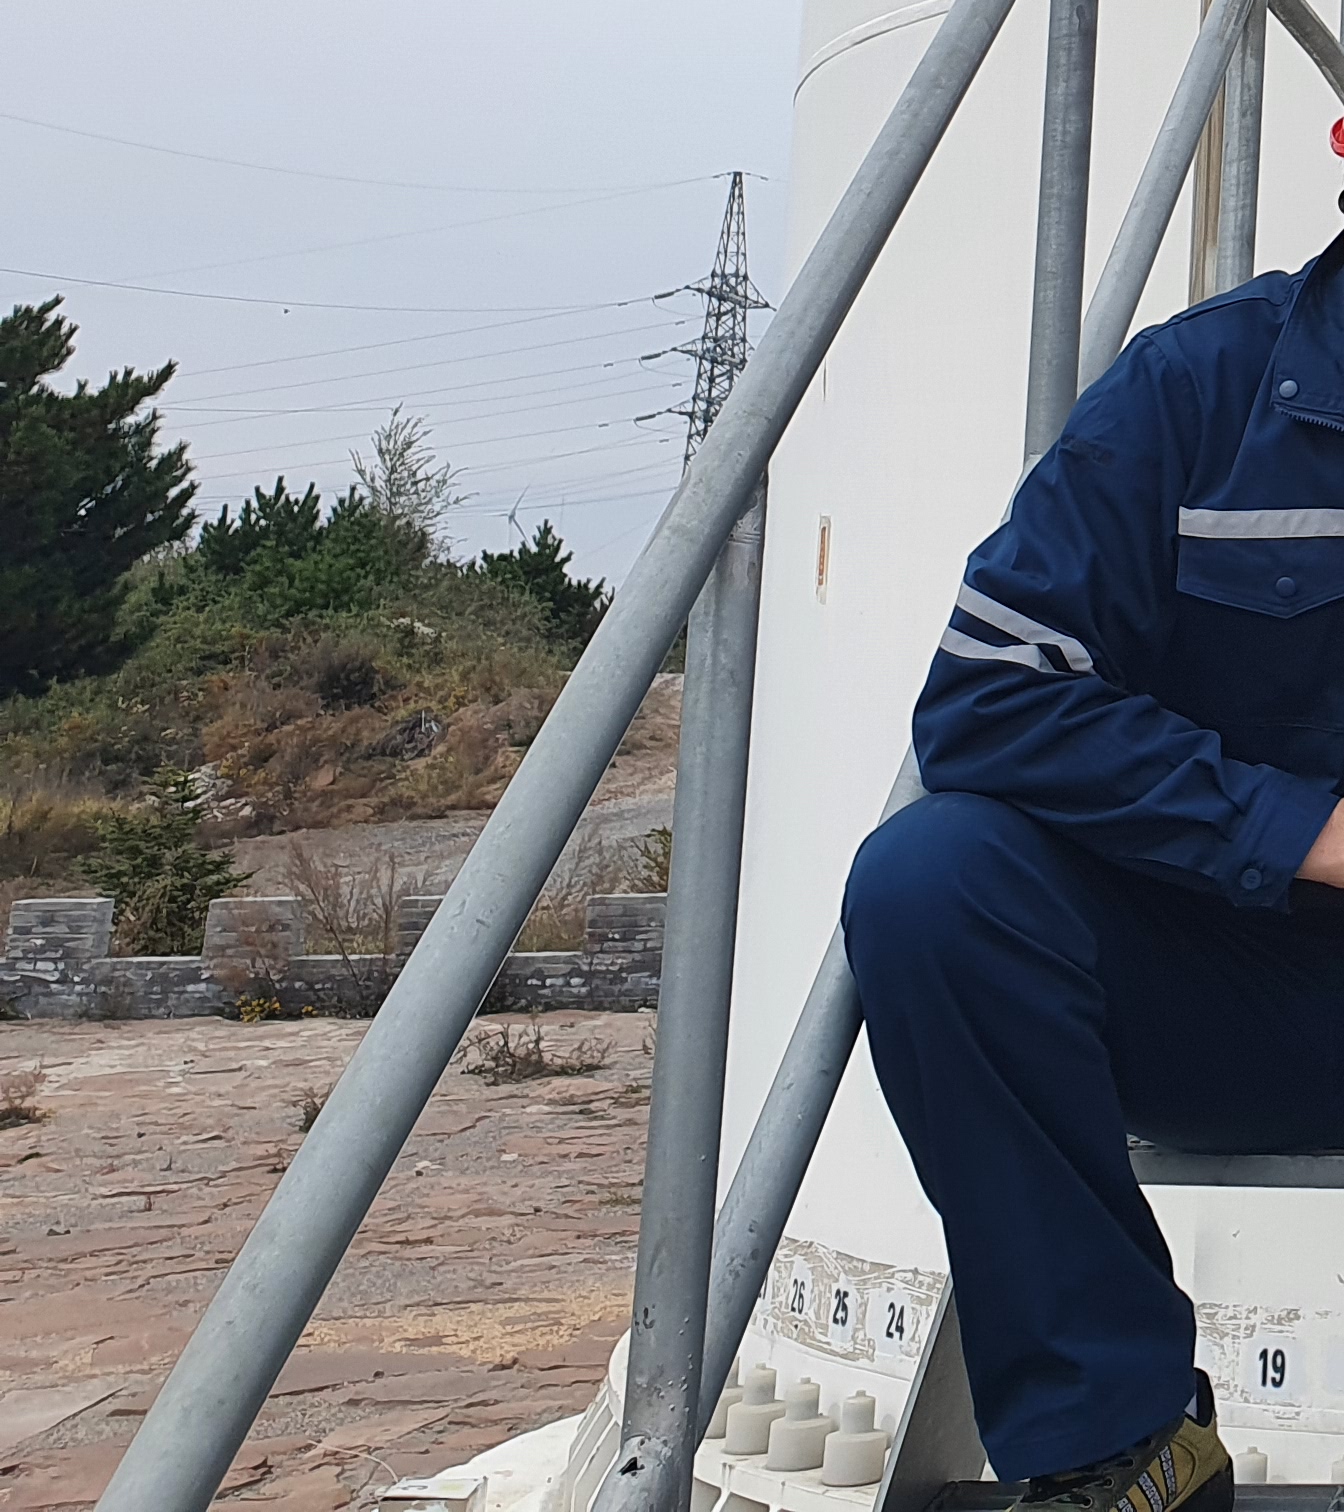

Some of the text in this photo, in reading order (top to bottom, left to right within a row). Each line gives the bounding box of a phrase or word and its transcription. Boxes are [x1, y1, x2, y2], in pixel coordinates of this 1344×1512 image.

[791, 1278, 806, 1315] 26
[832, 1288, 849, 1327] 25
[885, 1301, 905, 1341] 24
[1258, 1347, 1287, 1390] 19
